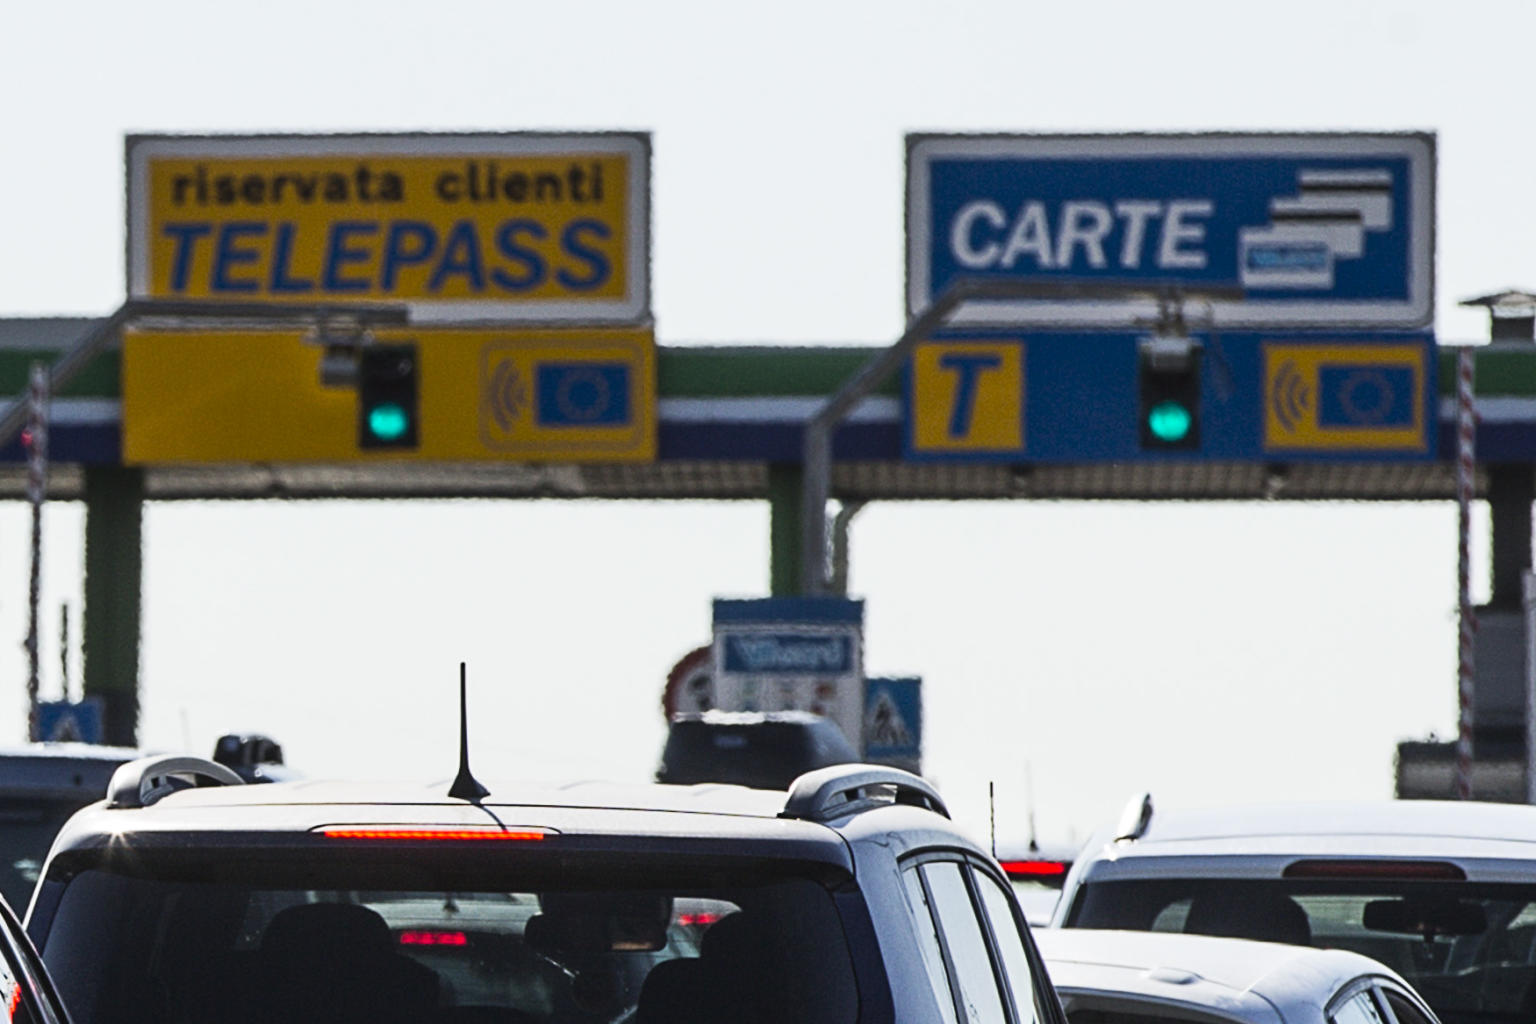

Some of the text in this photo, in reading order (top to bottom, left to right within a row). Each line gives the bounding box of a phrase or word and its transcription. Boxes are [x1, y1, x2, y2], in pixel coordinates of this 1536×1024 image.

[171, 163, 603, 205] riservata clienti
[161, 218, 613, 293] TELEPASS
[950, 198, 1215, 270] CARTE
[937, 353, 1001, 440] T
